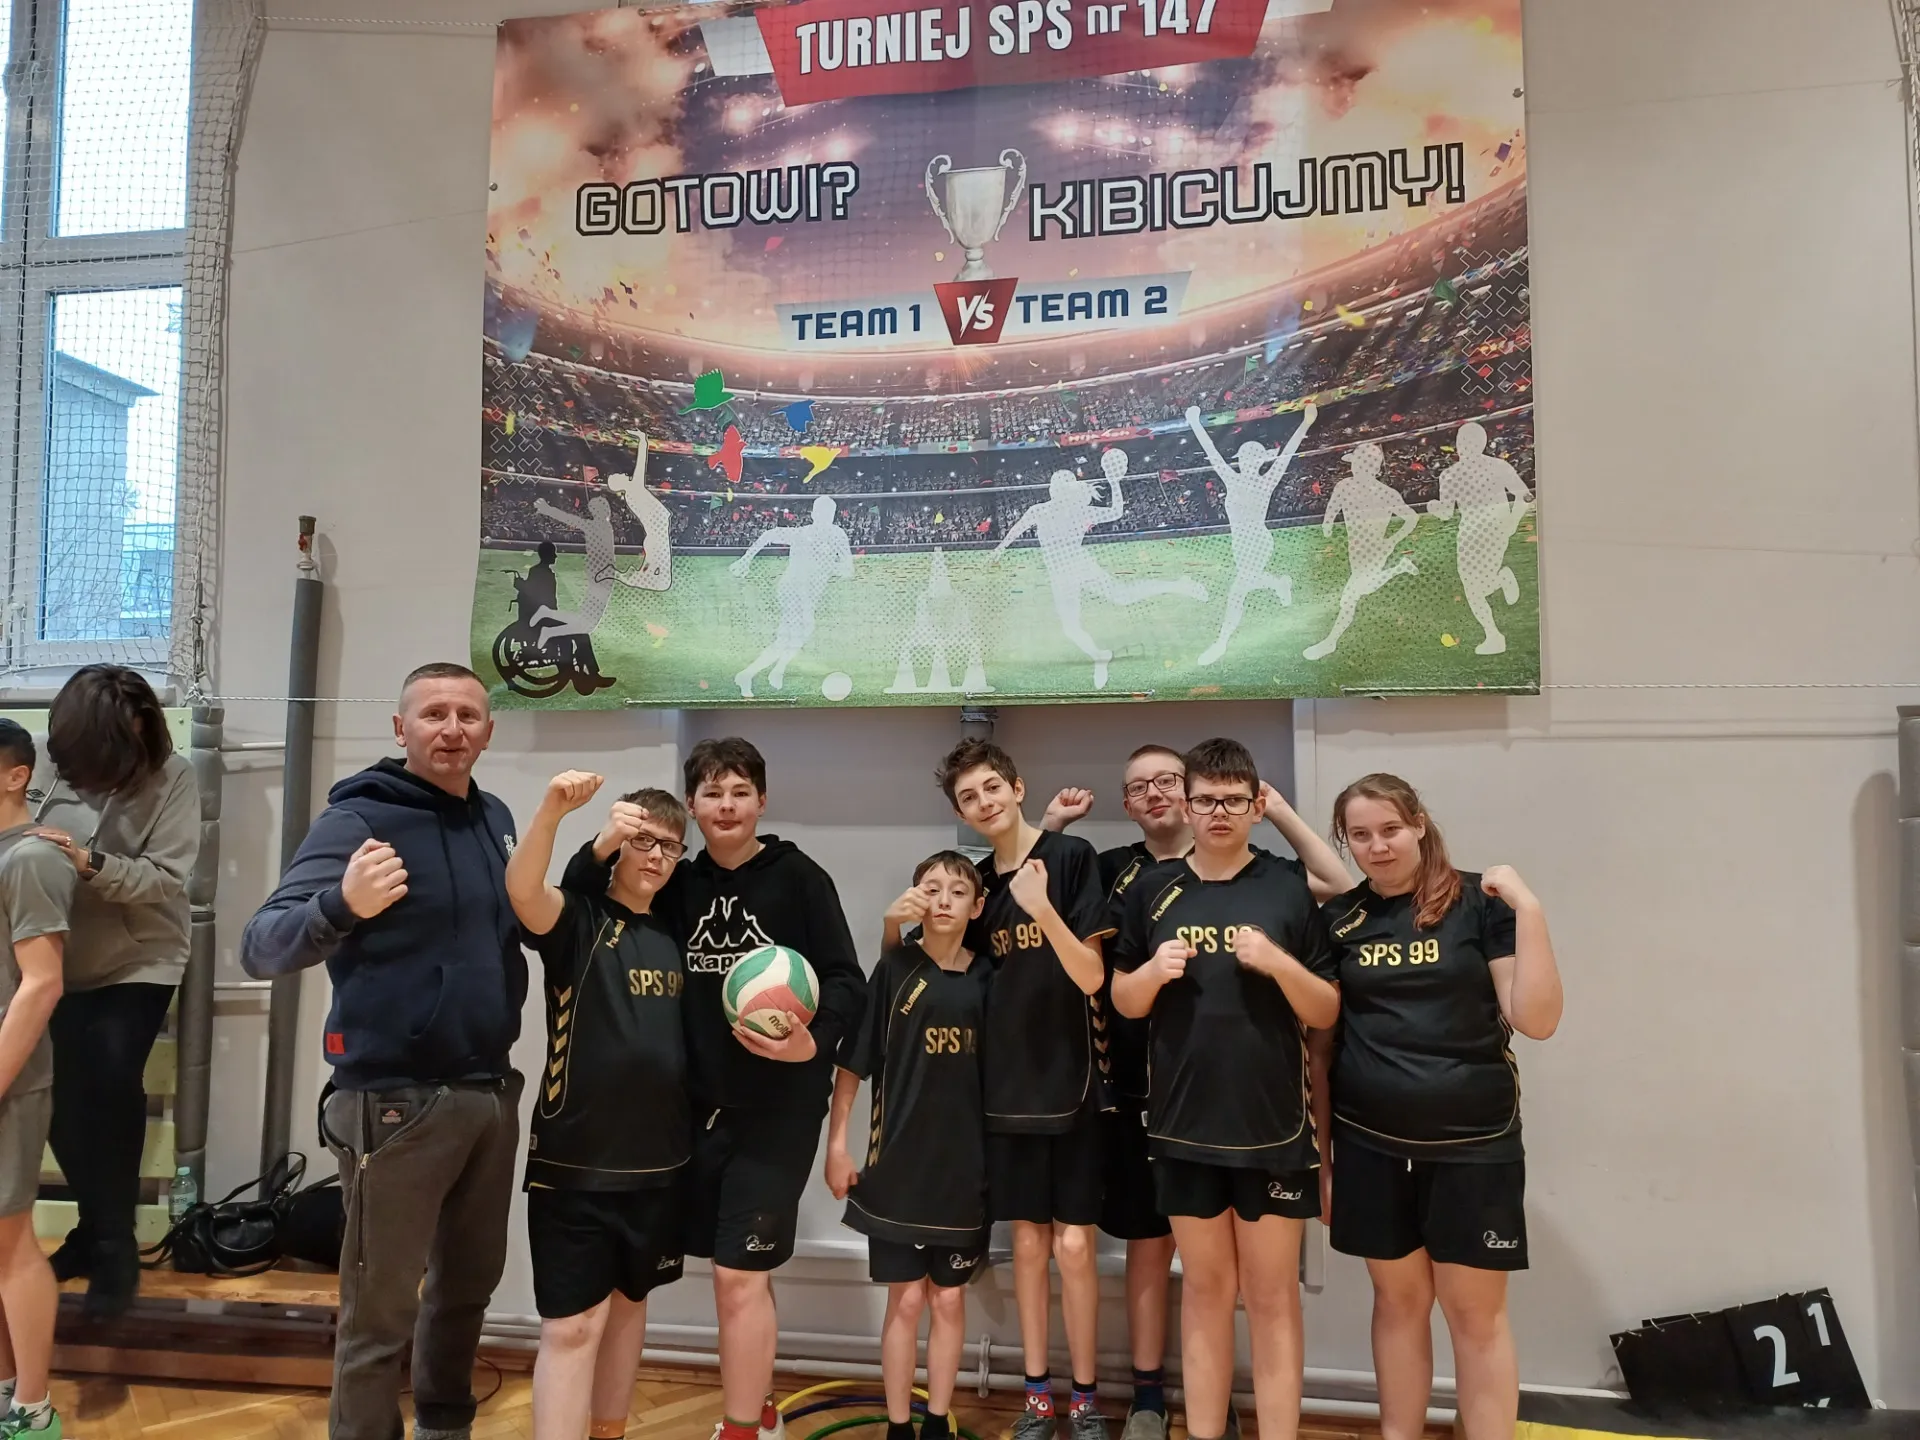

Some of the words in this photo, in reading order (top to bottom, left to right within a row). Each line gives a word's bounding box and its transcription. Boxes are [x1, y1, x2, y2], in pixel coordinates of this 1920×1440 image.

[796, 5, 971, 75] TURNIEJ
[988, 0, 1073, 55] SPS
[1087, 4, 1127, 36] nr
[576, 161, 859, 236] GOTOWI?
[1029, 142, 1465, 241] KIBICUJMY!
[791, 306, 897, 341] TEAM
[908, 304, 921, 332] 1
[1015, 288, 1129, 324] TEAM
[1144, 285, 1168, 315] 2
[1151, 885, 1183, 921] hummel
[1016, 922, 1042, 950] 99
[1224, 925, 1253, 953] 9
[1358, 943, 1402, 967] SPS
[1409, 938, 1440, 965] 99
[628, 968, 664, 996] SPS
[900, 978, 928, 1015] hummel
[768, 1015, 792, 1037] molte
[925, 1027, 961, 1054] SPS
[1806, 1302, 1831, 1346] 1
[1753, 1324, 1800, 1388] 2
